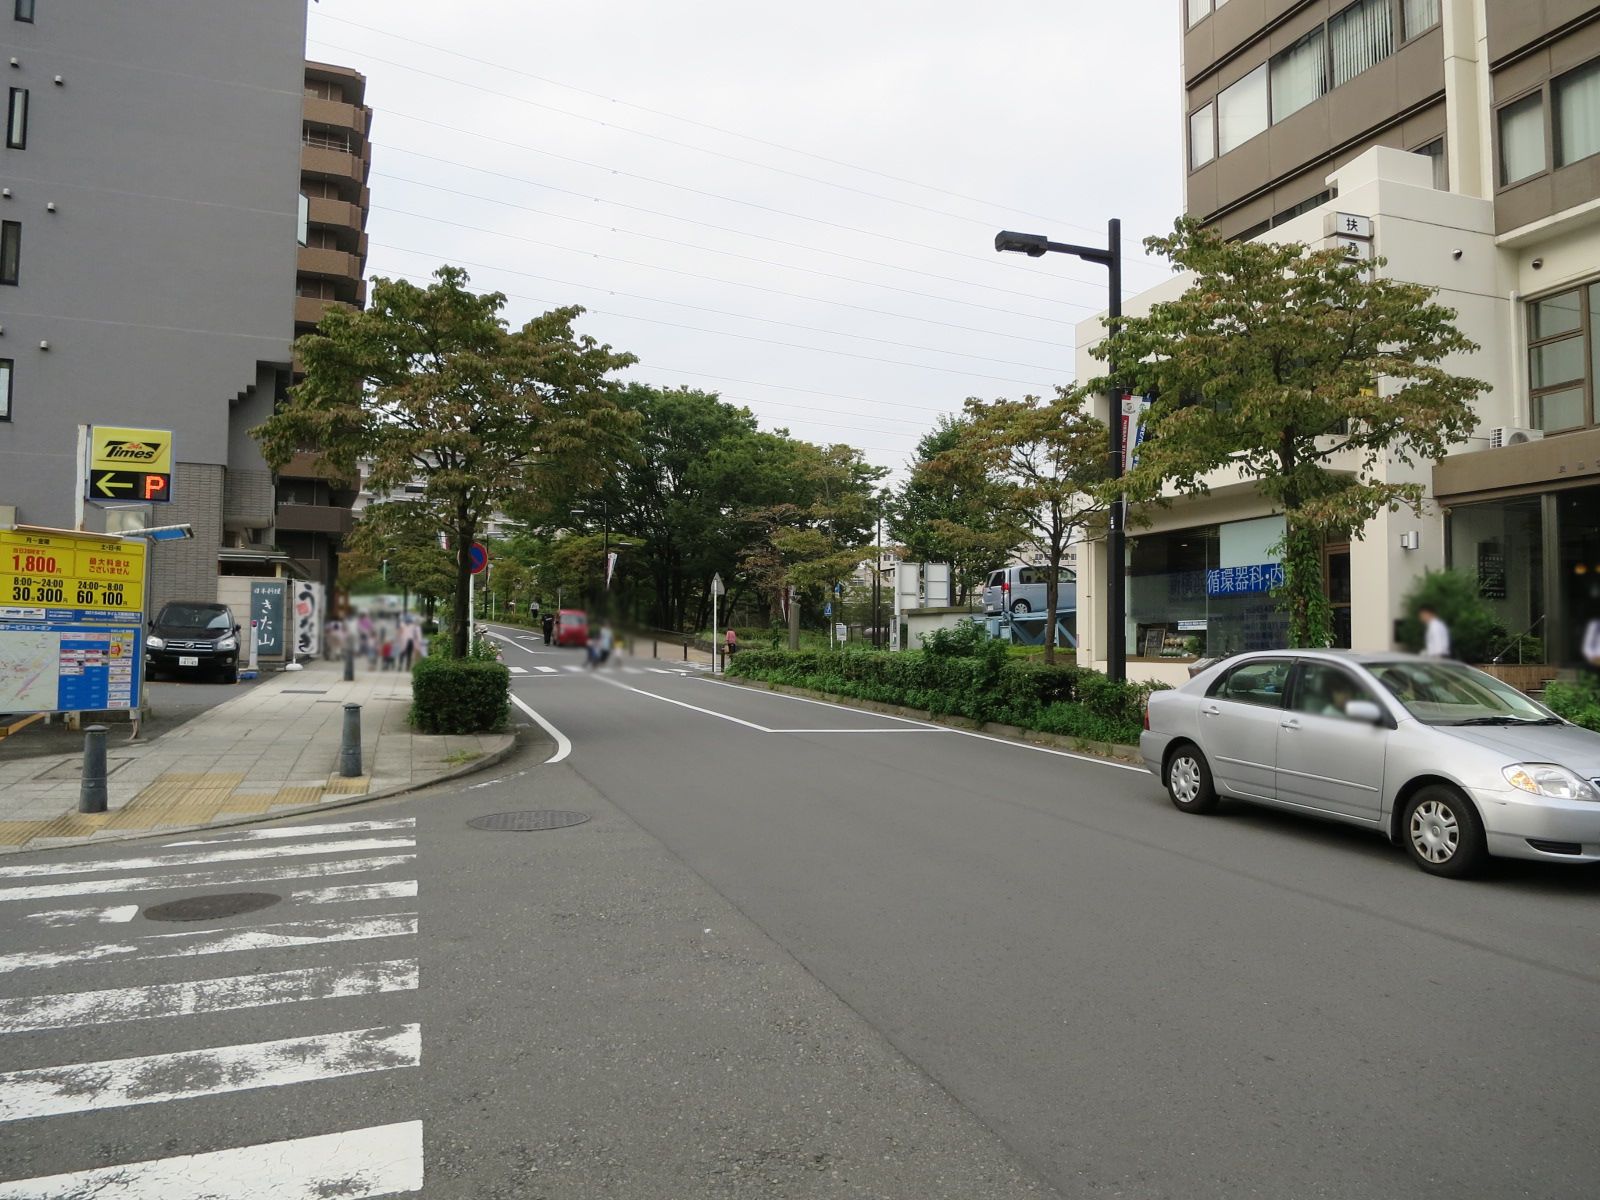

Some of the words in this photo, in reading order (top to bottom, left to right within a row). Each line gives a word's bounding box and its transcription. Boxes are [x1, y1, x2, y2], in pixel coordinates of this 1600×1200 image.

[104, 441, 155, 459] Times
[145, 475, 165, 500] P
[258, 599, 275, 646] きた山
